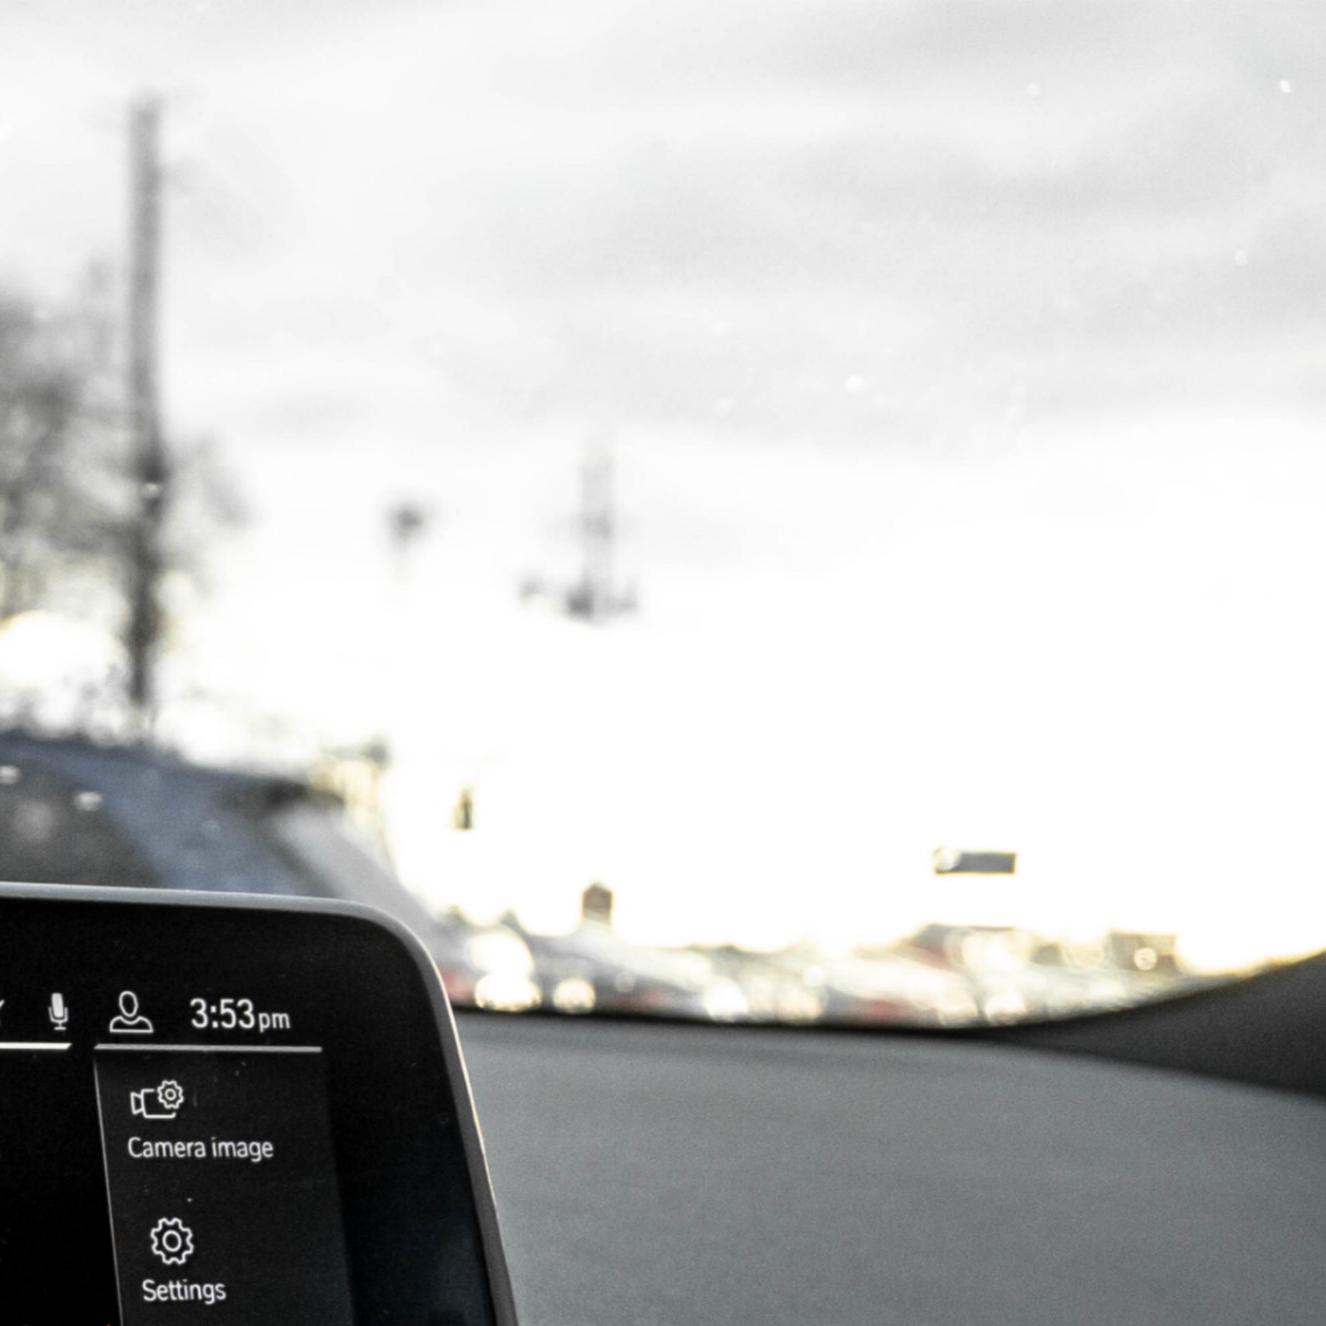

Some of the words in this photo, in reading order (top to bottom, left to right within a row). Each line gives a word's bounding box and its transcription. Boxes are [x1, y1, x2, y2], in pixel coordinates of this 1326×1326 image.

[127, 1136, 207, 1159] Camera
[210, 1136, 274, 1163] image
[141, 1278, 227, 1304] Settings
